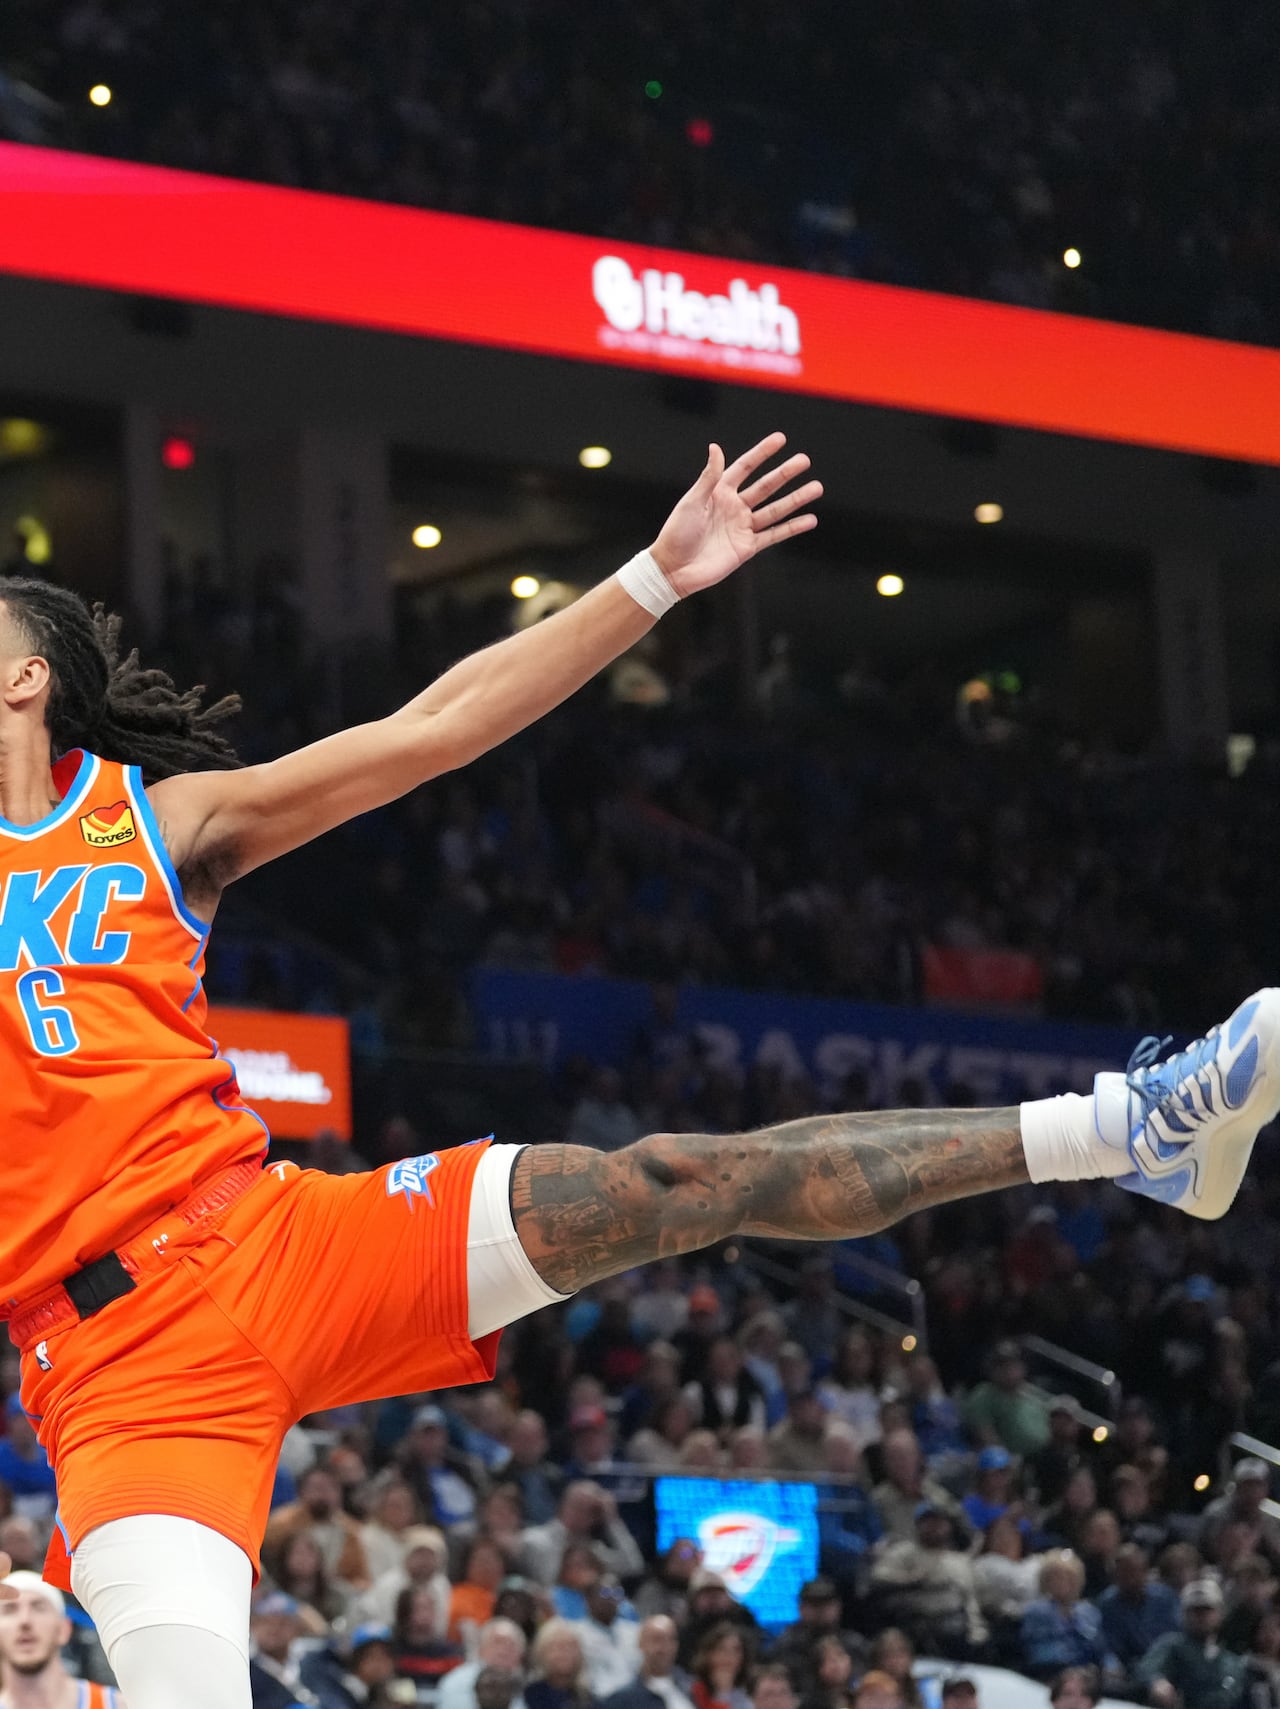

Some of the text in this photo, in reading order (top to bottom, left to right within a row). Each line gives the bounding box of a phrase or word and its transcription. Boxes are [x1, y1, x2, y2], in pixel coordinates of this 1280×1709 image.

[641, 268, 800, 356] Health
[16, 966, 80, 1057] 6
[694, 1021, 1124, 1104] ASKET
